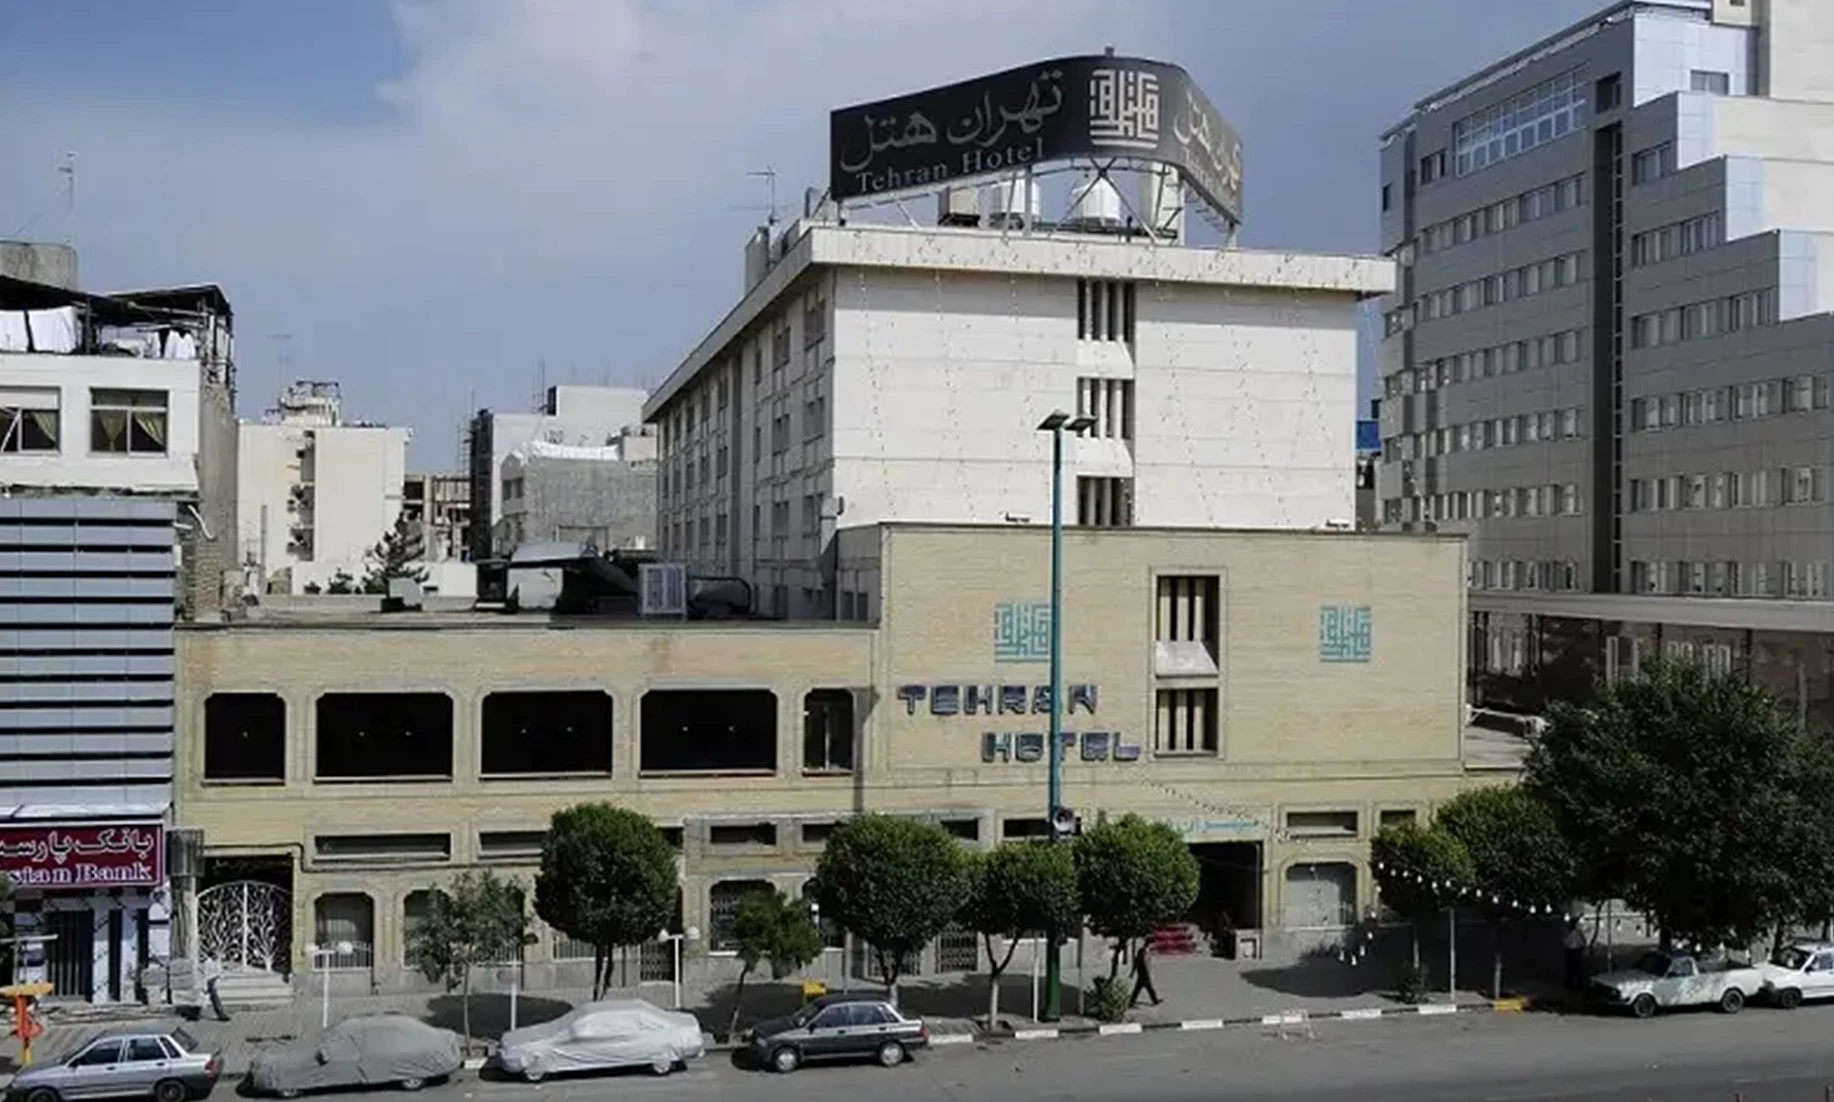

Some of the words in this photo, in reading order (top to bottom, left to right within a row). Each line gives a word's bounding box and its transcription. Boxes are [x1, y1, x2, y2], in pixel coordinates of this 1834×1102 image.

[946, 69, 1064, 148] تهران
[840, 111, 939, 173] هتل
[855, 160, 949, 193] Tehran
[962, 136, 1044, 173] Hotel
[897, 684, 1098, 716] TEHRAN
[981, 732, 1141, 763] HOTEL
[75, 828, 154, 860] بانک
[75, 862, 152, 883] Bank
